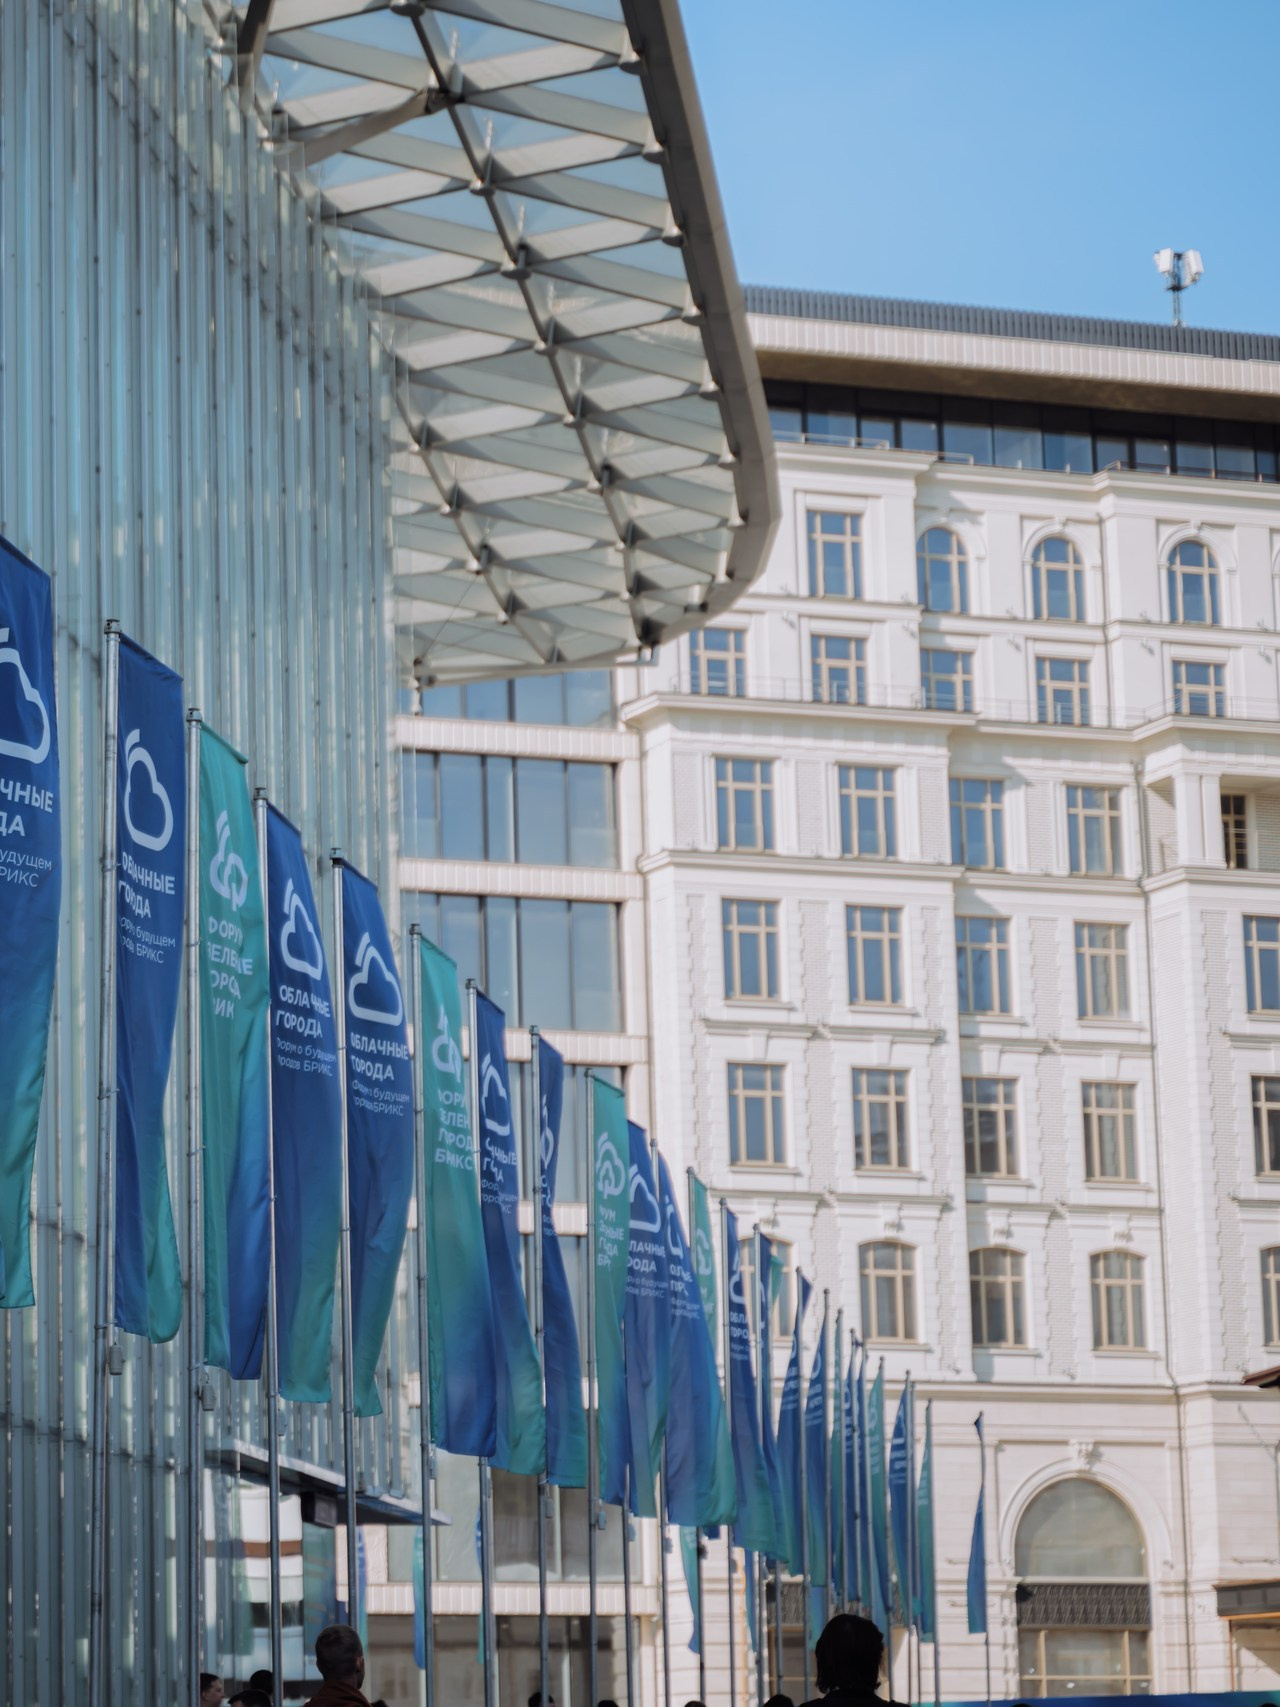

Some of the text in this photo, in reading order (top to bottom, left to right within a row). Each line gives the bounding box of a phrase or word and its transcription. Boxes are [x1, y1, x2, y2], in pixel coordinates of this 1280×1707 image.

[276, 1010, 323, 1039] ГОРОДА
[350, 1031, 409, 1061] ОБЛАЧНЫЕ
[350, 1055, 394, 1082] ГОРОДА
[374, 1099, 404, 1116] БРИКС
